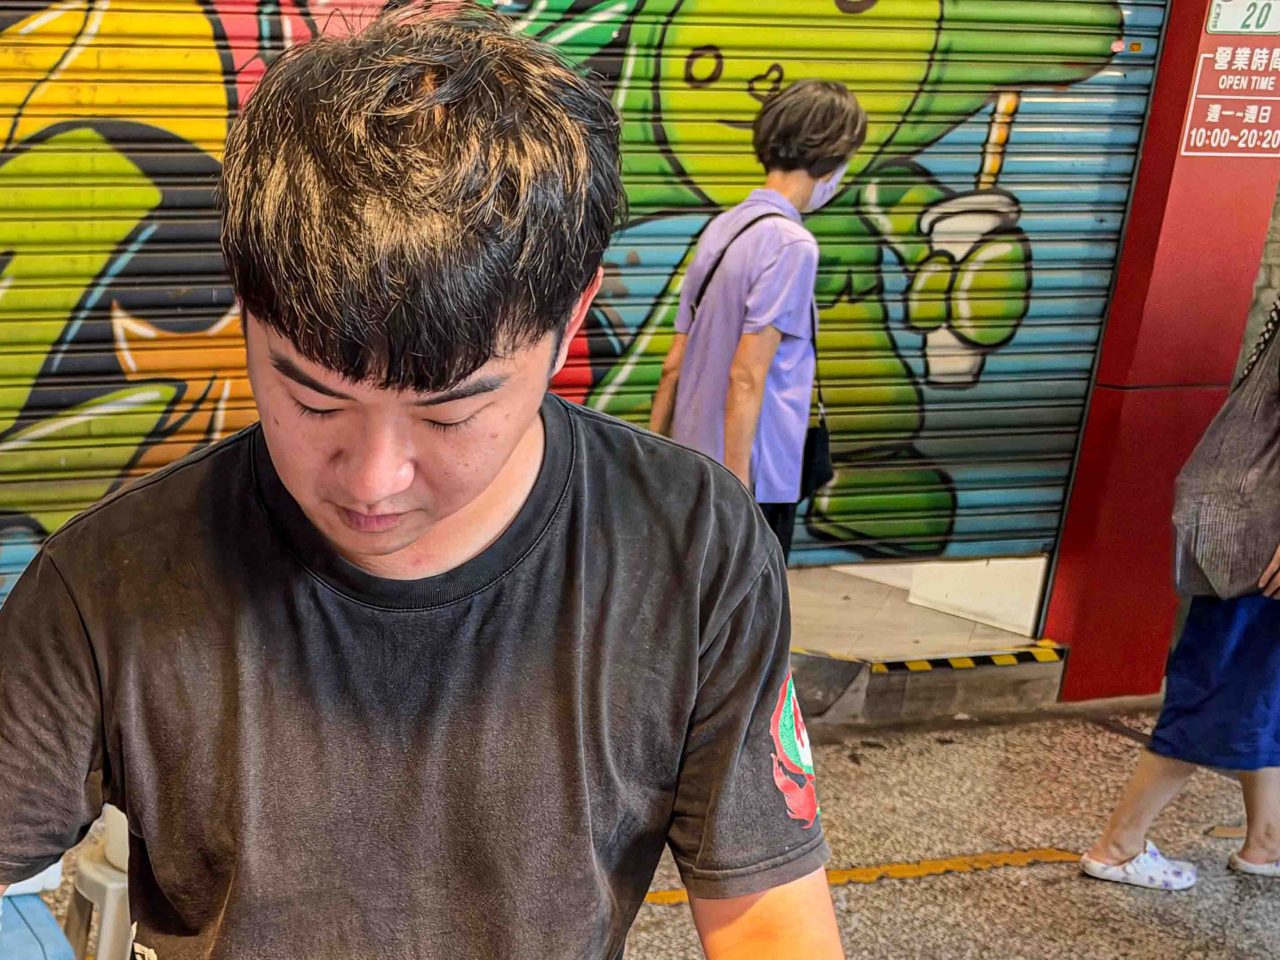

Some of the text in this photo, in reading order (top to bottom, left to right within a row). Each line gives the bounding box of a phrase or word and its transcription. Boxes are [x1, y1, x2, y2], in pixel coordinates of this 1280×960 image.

[1241, 2, 1272, 29] 20
[1218, 75, 1276, 91] OPEN TIME
[1189, 127, 1280, 148] 10:00~20:20
